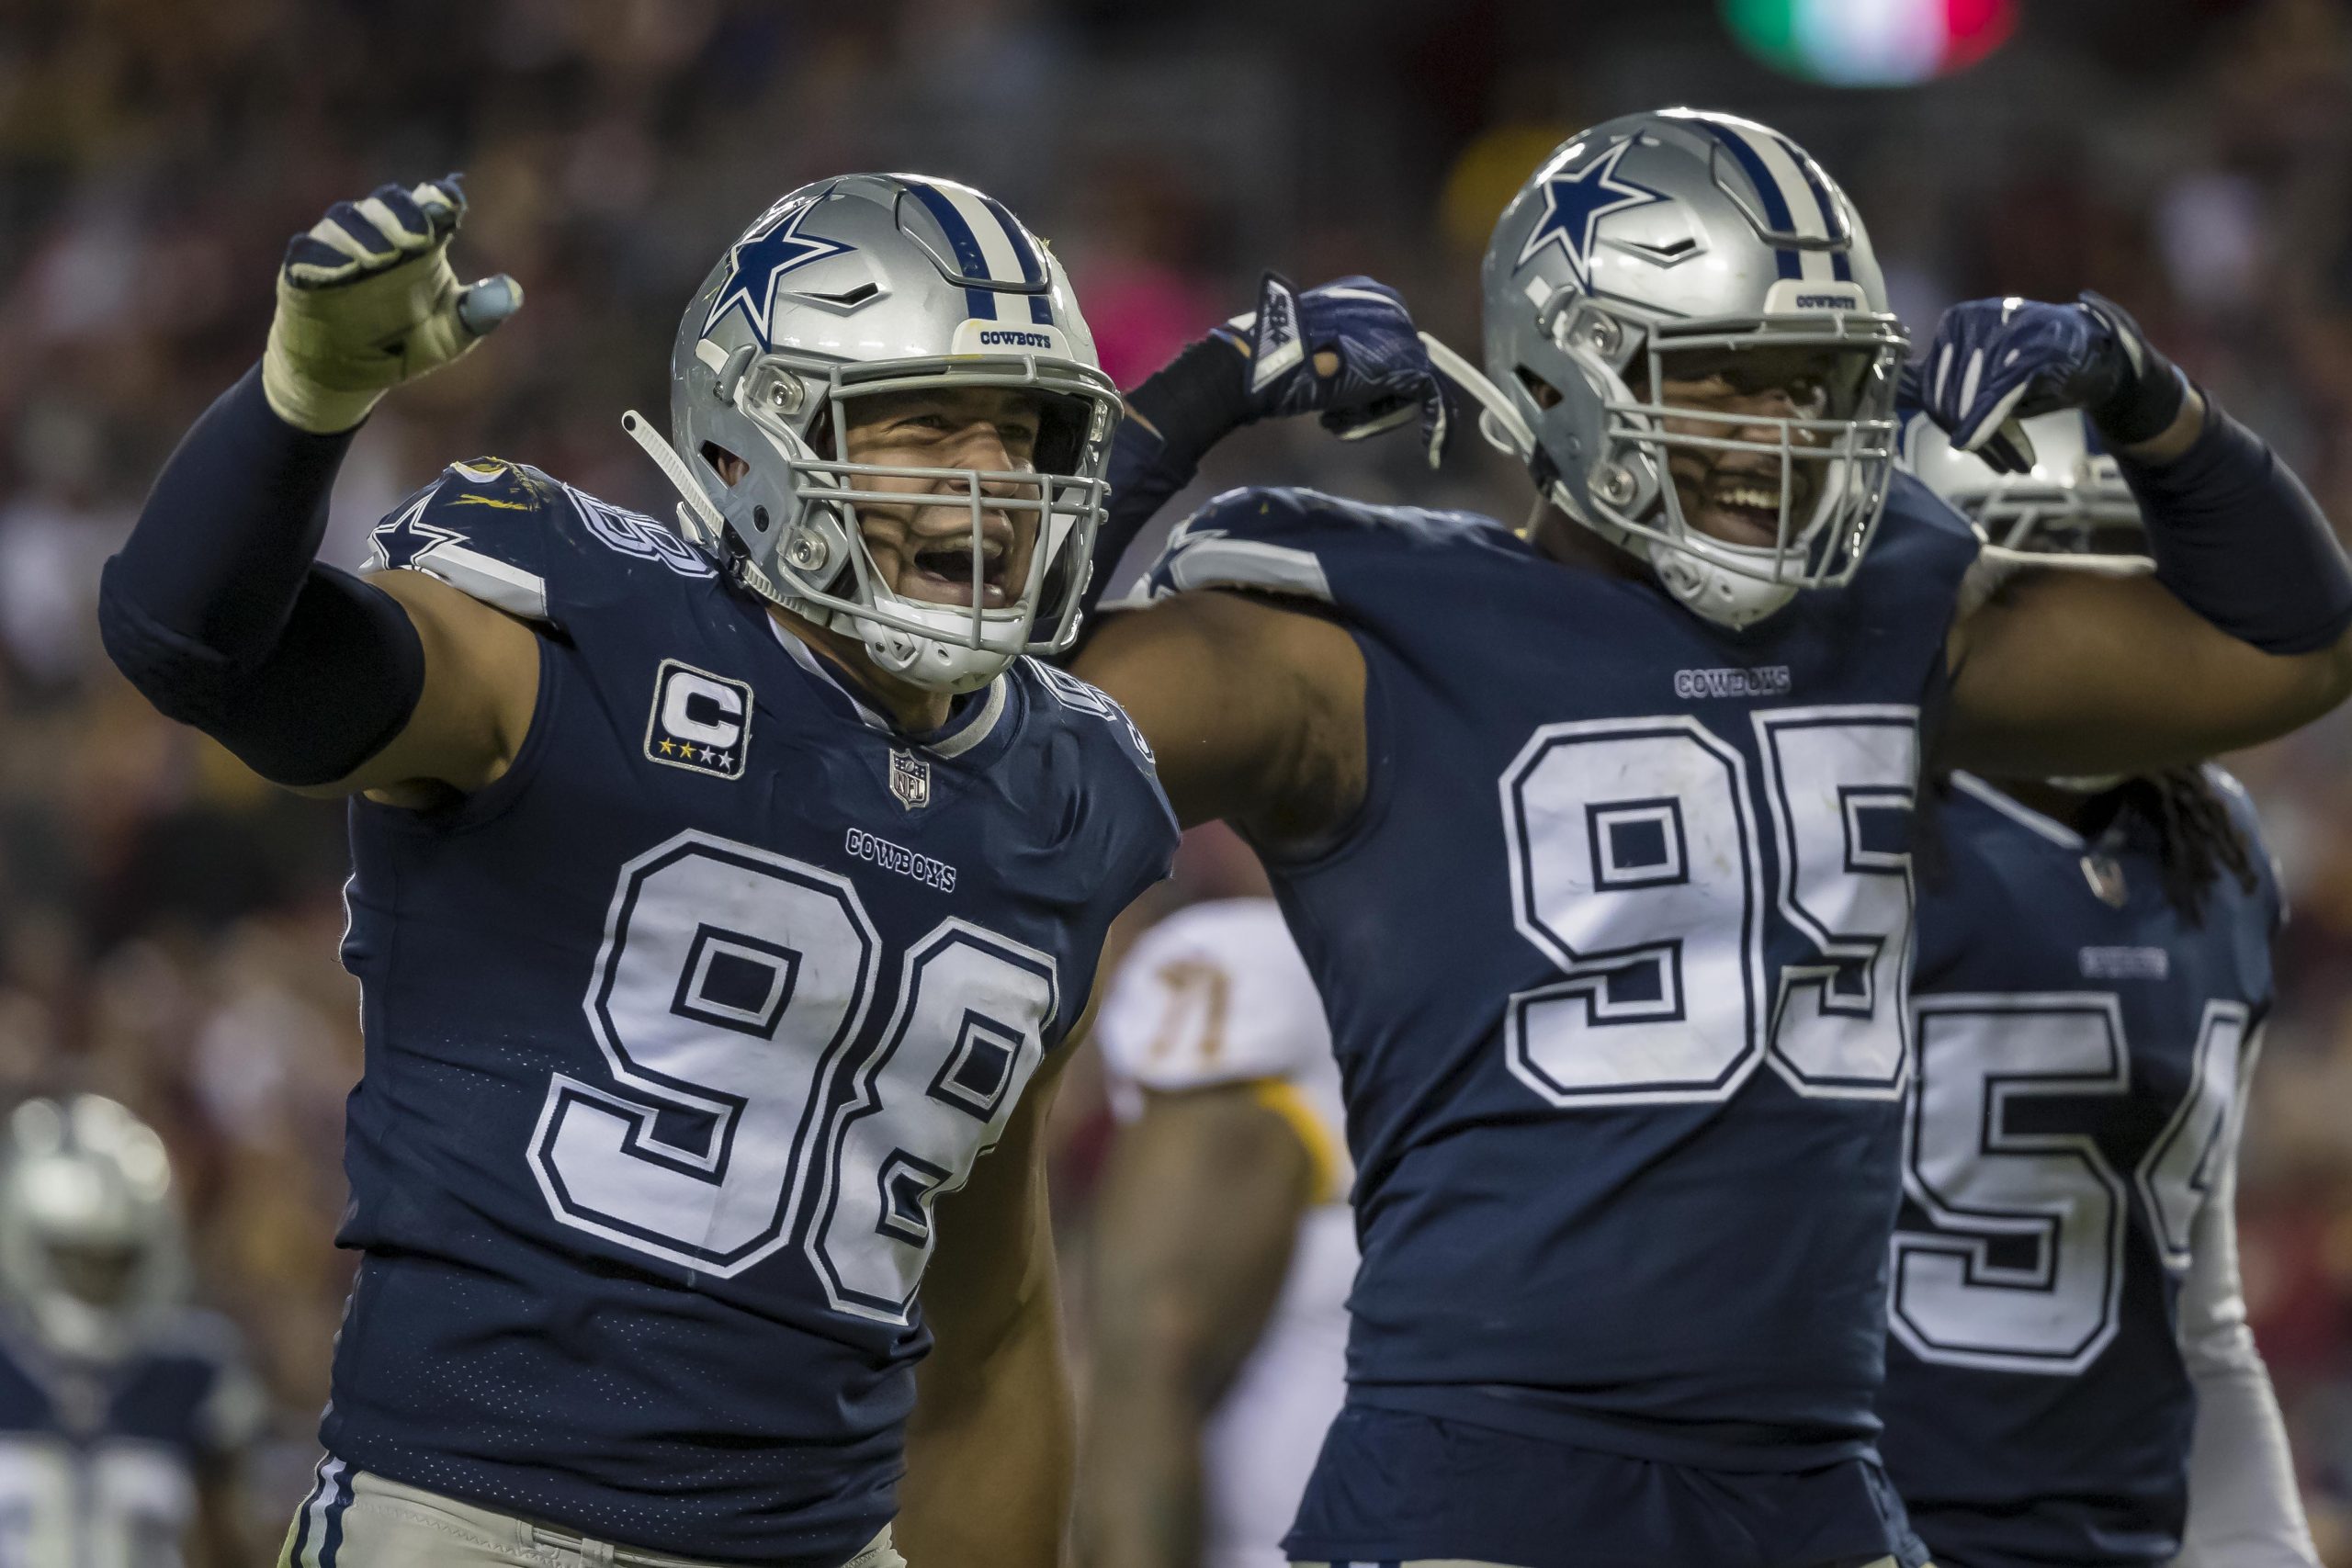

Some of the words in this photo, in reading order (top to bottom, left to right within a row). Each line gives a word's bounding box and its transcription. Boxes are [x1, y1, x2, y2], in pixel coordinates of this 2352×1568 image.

[979, 331, 1051, 349] COWBOYS
[662, 672, 742, 749] C
[1674, 665, 1791, 698] COWBOYS
[845, 829, 956, 893] COWBOYS
[1498, 705, 1920, 1108] 95
[526, 828, 1060, 1327] 98
